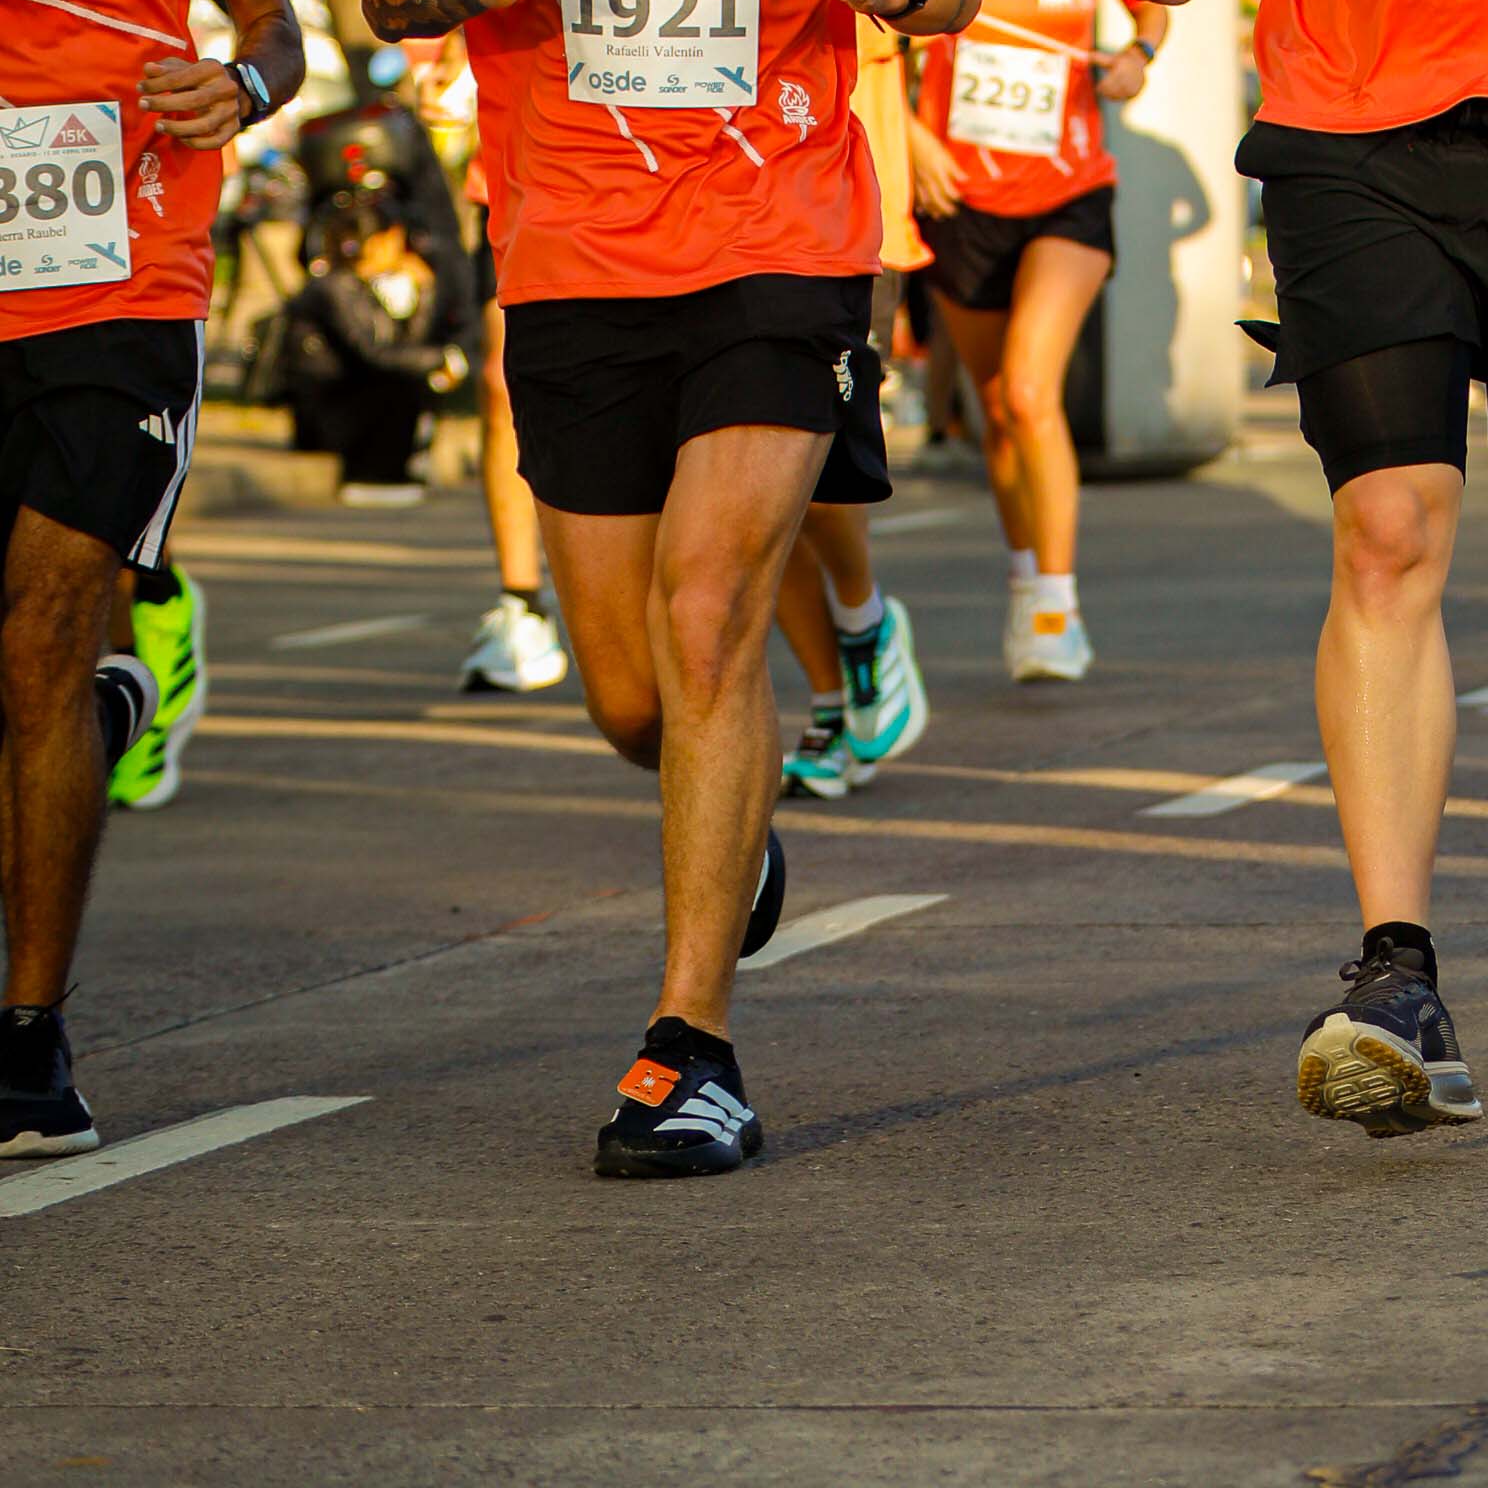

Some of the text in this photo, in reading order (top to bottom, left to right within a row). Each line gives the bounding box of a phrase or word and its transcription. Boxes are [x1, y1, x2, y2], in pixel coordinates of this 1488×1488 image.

[606, 44, 650, 57] Rafaelli
[960, 72, 1057, 112] 2293
[60, 128, 88, 144] 15K
[26, 225, 67, 240] Raubel
